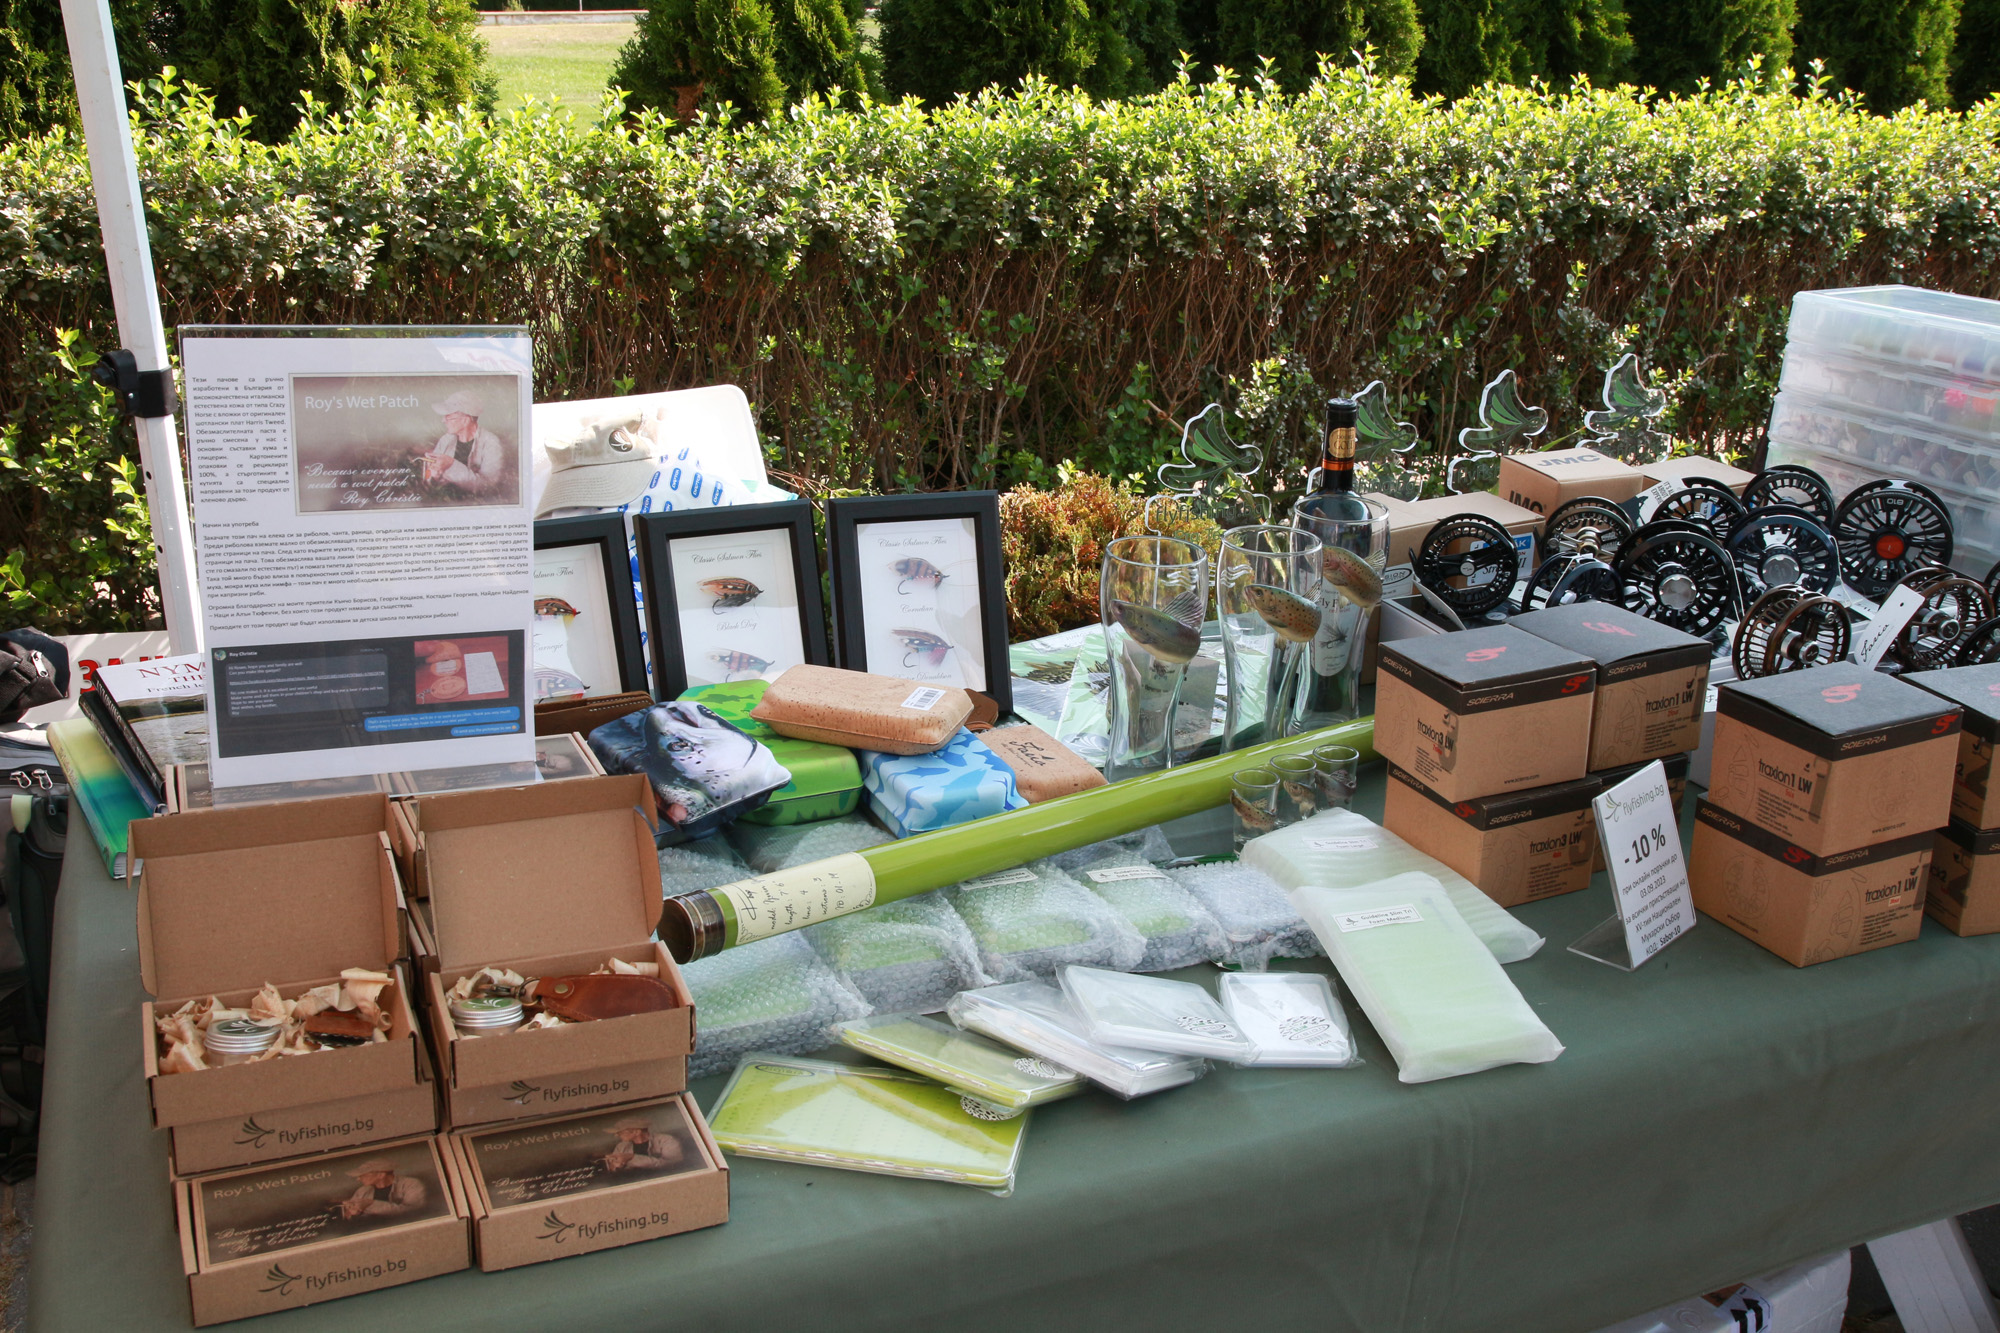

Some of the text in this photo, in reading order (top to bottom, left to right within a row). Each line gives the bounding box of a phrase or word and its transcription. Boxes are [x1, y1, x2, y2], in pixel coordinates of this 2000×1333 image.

[305, 395, 419, 412] Roy's Wet Patch
[1537, 453, 1602, 468] JMC
[307, 478, 374, 490] needs a wet
[360, 467, 411, 478] everyone
[340, 489, 423, 508] Roy Christie
[1156, 500, 1264, 526] flyfishing.bg
[877, 535, 947, 549] Classic Salmon Flies
[691, 549, 763, 565] Classic Salmon Flies
[555, 566, 574, 577] Flies
[716, 619, 758, 632] Black Dog
[916, 671, 952, 681] Donaldson
[1382, 656, 1412, 678] SCIERRA
[1607, 661, 1648, 677] SCIERRA
[146, 683, 191, 693] French
[1466, 692, 1515, 707] SCIERRA
[1645, 689, 1694, 713] traxion1 LW
[1416, 718, 1455, 752] traxion3 LW
[1840, 734, 1887, 752] SCIERRA
[1392, 769, 1425, 792] SCIERRA
[1758, 758, 1813, 795] traxion1 LW
[1622, 783, 1665, 816] flyfishing.bg
[1489, 809, 1533, 825] SCIERRA
[1701, 807, 1741, 832] SCIERRA
[1529, 830, 1582, 855] traxion3 LW
[1631, 823, 1667, 865] 10 %
[1825, 849, 1869, 866] SCIERRA
[1622, 853, 1678, 896] при онлайн поръчки до
[1639, 875, 1666, 899] 03.09.2023
[1865, 876, 1918, 903] traxion1 LW
[1625, 877, 1686, 926] за всички присъстващи на
[1360, 912, 1389, 921] Guideline
[1635, 896, 1681, 933] XV-тия Национален
[1641, 911, 1681, 944] Мухарски Събор
[1645, 925, 1681, 957] КОД: Sabor-10
[543, 1080, 630, 1102] flyfishing.bg
[278, 1118, 374, 1145] flyfishing.bg
[484, 1126, 591, 1152] Roy's Wet Patch
[213, 1169, 332, 1200] Roy's Wet Patch
[578, 1212, 669, 1239] flyfishing.bg
[305, 1259, 407, 1290] flyfishing.bg
